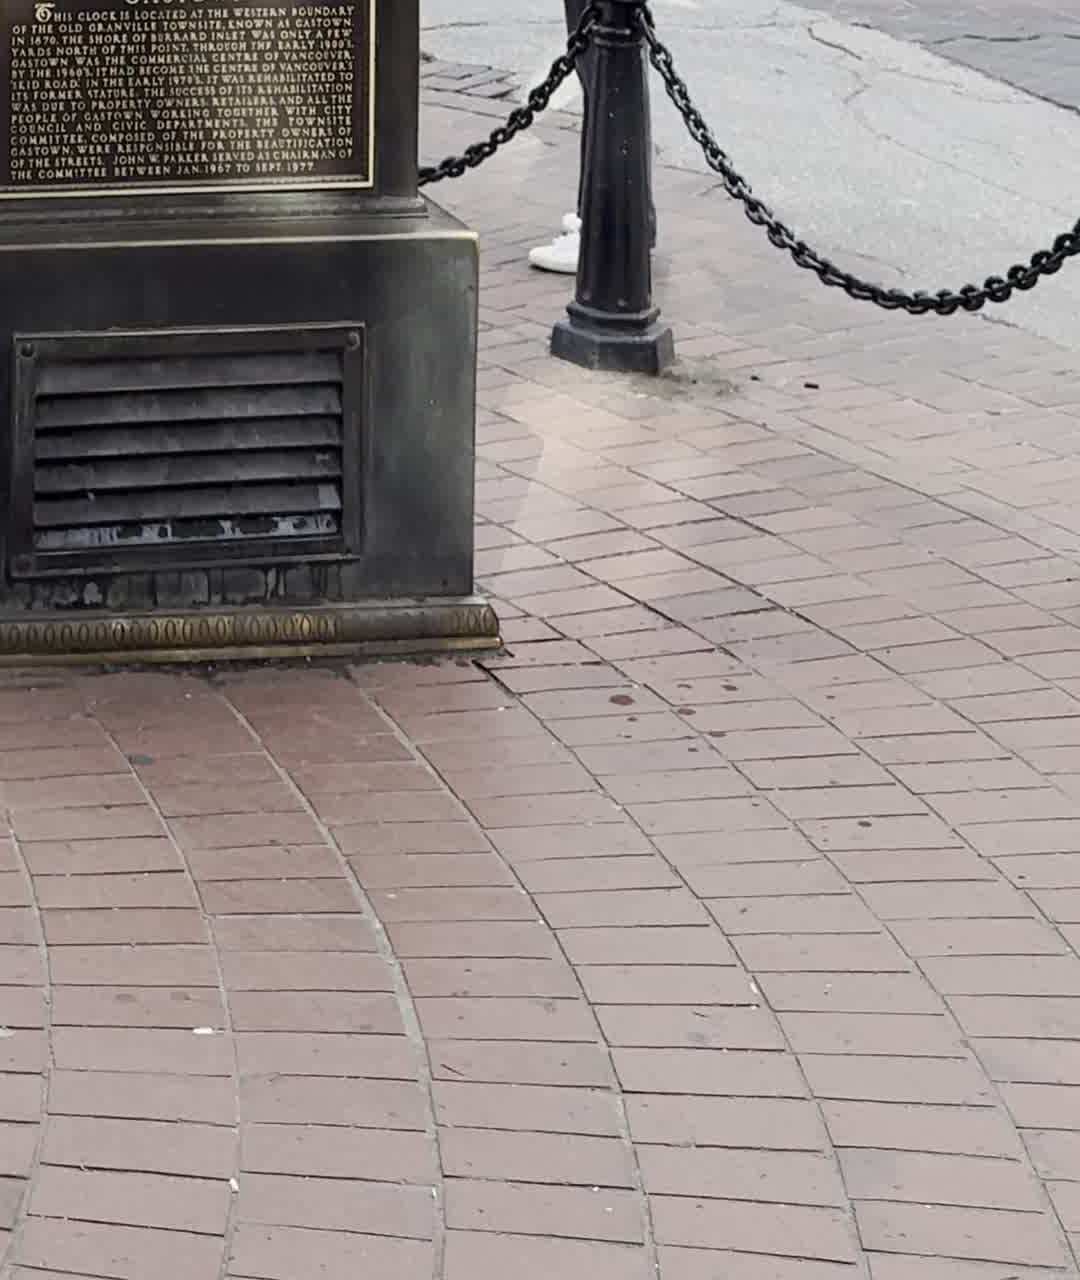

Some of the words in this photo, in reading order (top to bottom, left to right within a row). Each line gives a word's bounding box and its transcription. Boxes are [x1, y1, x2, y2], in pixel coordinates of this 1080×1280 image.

[34, 2, 73, 22] THIS
[77, 10, 117, 21] CLOCK
[119, 10, 130, 20] IS
[134, 9, 187, 20] LOCATED
[190, 8, 204, 19] AT
[207, 8, 229, 18] THE
[232, 7, 286, 18] WESTERN
[291, 6, 354, 17] BOUNDARY
[12, 23, 27, 34] OF
[31, 23, 53, 33] THE
[58, 22, 82, 33] OLD
[88, 21, 157, 32] GRANVILLE
[228, 19, 273, 29] KNOWN
[277, 19, 290, 28] AS
[11, 35, 25, 45] IN
[61, 34, 83, 44] THE
[88, 33, 127, 43] SHORE
[132, 33, 146, 42] OF
[150, 31, 207, 42] BURRARD
[210, 31, 246, 41] INLET
[250, 30, 275, 40] WAS
[279, 29, 313, 39] ONLY
[314, 29, 323, 39] A
[327, 29, 352, 39] FEW
[11, 45, 51, 56] YARDS
[56, 45, 97, 55] NORTH
[100, 44, 116, 54] OF
[119, 44, 146, 54] THIS
[192, 42, 246, 52] THROUGH
[250, 41, 273, 51] THE
[277, 40, 316, 50] EARLY
[11, 56, 68, 67] GASTOWN
[75, 56, 99, 66] WAS
[104, 55, 126, 65] THE
[131, 53, 207, 64] COMMERCIAL
[211, 52, 258, 63] CENTRE
[263, 52, 279, 62] OF
[11, 68, 25, 78] BY
[30, 67, 52, 77] THE
[95, 66, 107, 76] IT
[108, 66, 134, 76] HAD
[138, 64, 185, 75] BECOME
[188, 64, 209, 74] THE
[213, 63, 258, 73] CENTRE
[261, 62, 276, 72] OF
[85, 77, 99, 87] IN
[102, 77, 124, 87] THE
[127, 76, 164, 86] EARLY
[206, 75, 218, 84] IT
[221, 74, 244, 84] WAS
[248, 72, 335, 83] REHABILITATED
[338, 71, 353, 81] TO
[11, 90, 28, 100] ITS
[33, 89, 83, 100] FORMER
[143, 87, 166, 97] THE
[169, 86, 215, 96] SUCCESS
[218, 85, 232, 95] OF
[235, 85, 252, 95] ITS
[256, 82, 353, 94] REHABILITATION
[10, 102, 37, 112] WAS
[41, 101, 65, 111] DUE
[70, 100, 86, 110] TO
[90, 99, 151, 110] PROPERTY
[278, 95, 302, 105] AND
[306, 94, 329, 104] ALL
[331, 94, 353, 103] THE
[11, 112, 56, 123] PEOPLE
[61, 112, 77, 122] OF
[83, 110, 143, 121] GASTOWN
[150, 108, 211, 119] WORKING
[217, 106, 279, 118] TOGETHER
[285, 105, 316, 116] WITH
[323, 104, 353, 115] CITY
[9, 123, 66, 134] COUNCIL
[75, 122, 101, 132] AND
[112, 121, 147, 131] CIVIC
[255, 117, 279, 127] THE
[287, 115, 352, 126] TOWNSITE
[90, 131, 156, 143] COMPOSED
[162, 131, 177, 141] OF
[182, 130, 205, 140] THE
[212, 128, 275, 139] PROPERTY
[281, 126, 334, 137] OWNERS
[337, 126, 352, 136] OF
[76, 144, 111, 154] WERE
[116, 142, 195, 153] RESPONSIBLE
[200, 141, 224, 150] FOR
[229, 140, 252, 150] THE
[256, 137, 353, 149] BEAUTIFICATION
[9, 158, 26, 168] OF
[27, 157, 51, 167] THE
[111, 155, 145, 165] JOHN
[163, 153, 209, 163] PARKER
[212, 151, 254, 162] SERVED
[255, 151, 270, 160] AS
[272, 149, 336, 160] CHAIRMAN
[338, 148, 353, 158] OF
[9, 169, 32, 180] THE
[37, 167, 109, 179] COMMITTEE
[112, 165, 170, 176] BETWEEN
[204, 163, 230, 174] 1967
[235, 162, 251, 173] TO
